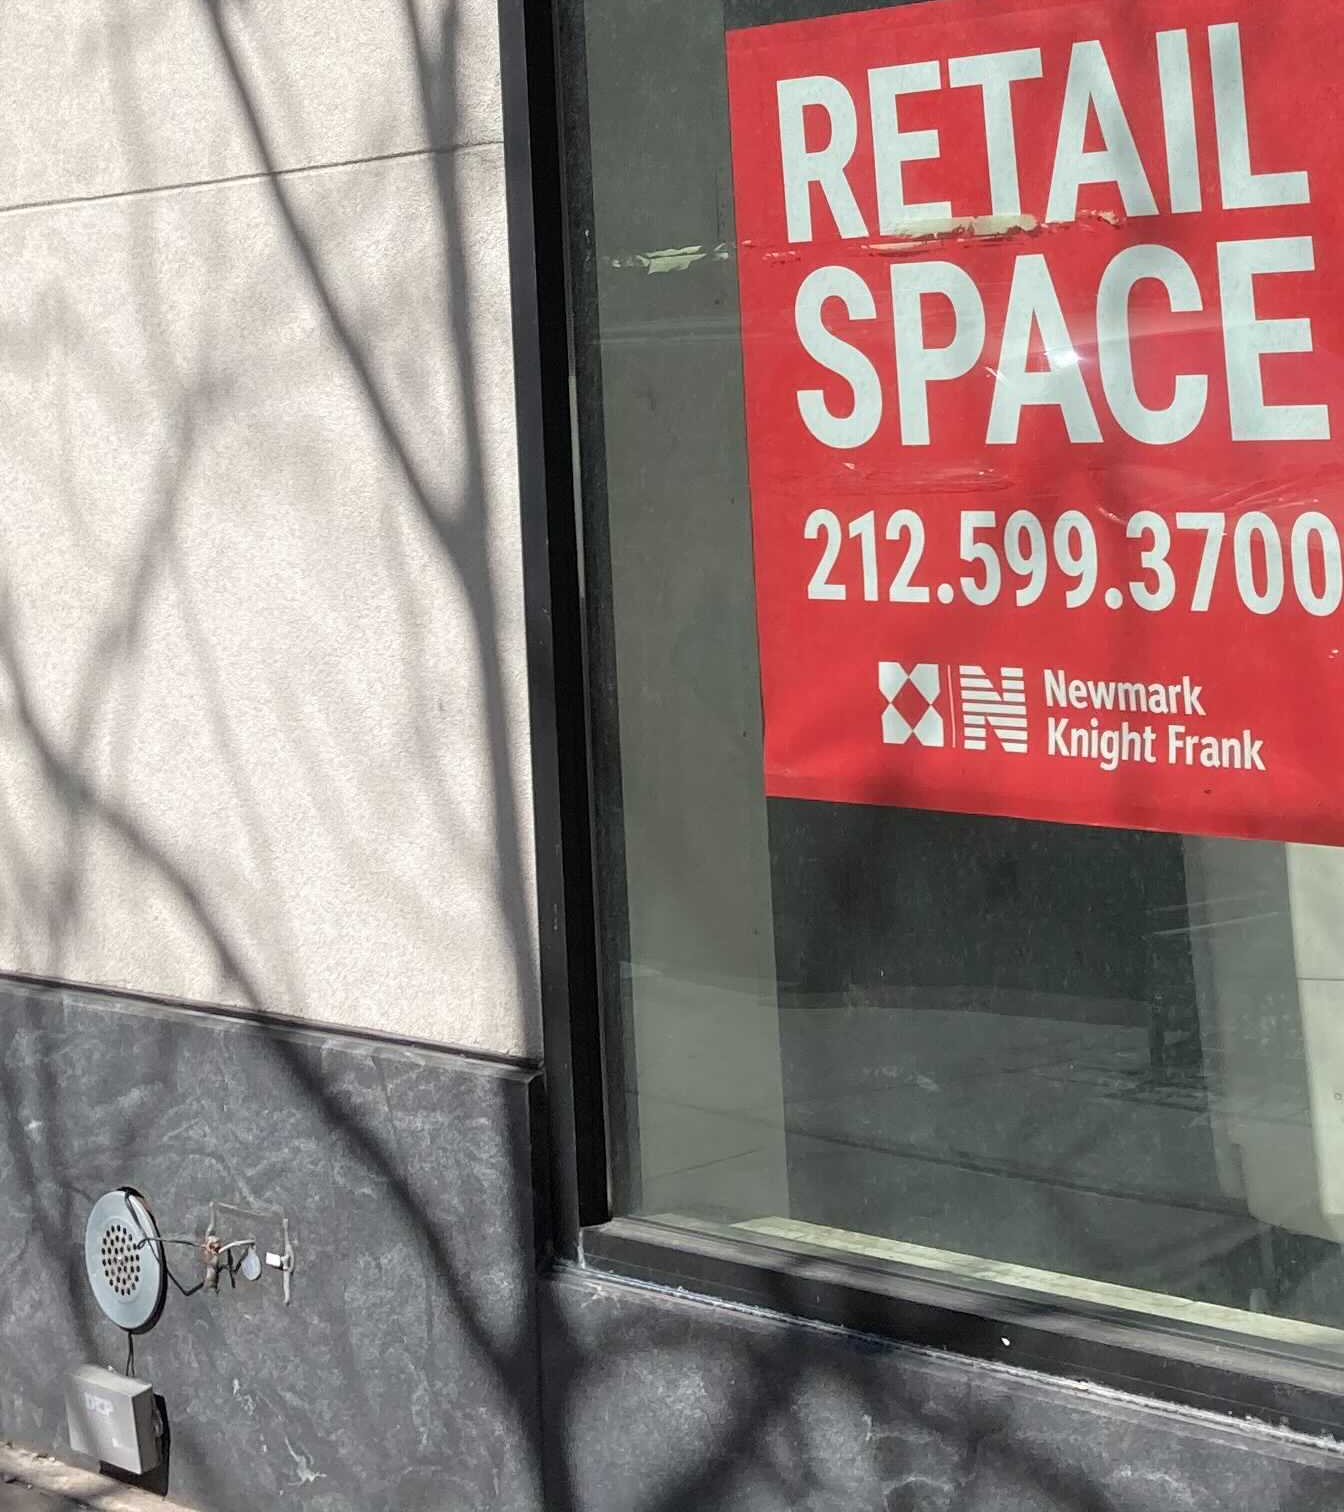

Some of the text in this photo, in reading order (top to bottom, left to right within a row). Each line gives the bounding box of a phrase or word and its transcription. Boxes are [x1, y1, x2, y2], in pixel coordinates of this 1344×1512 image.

[776, 22, 1311, 243] RETAIL
[794, 235, 1330, 449] SPACE
[803, 508, 1343, 616] 212.599.3700
[1043, 669, 1206, 716] Newmark
[1047, 718, 1266, 771] Knight Frank
